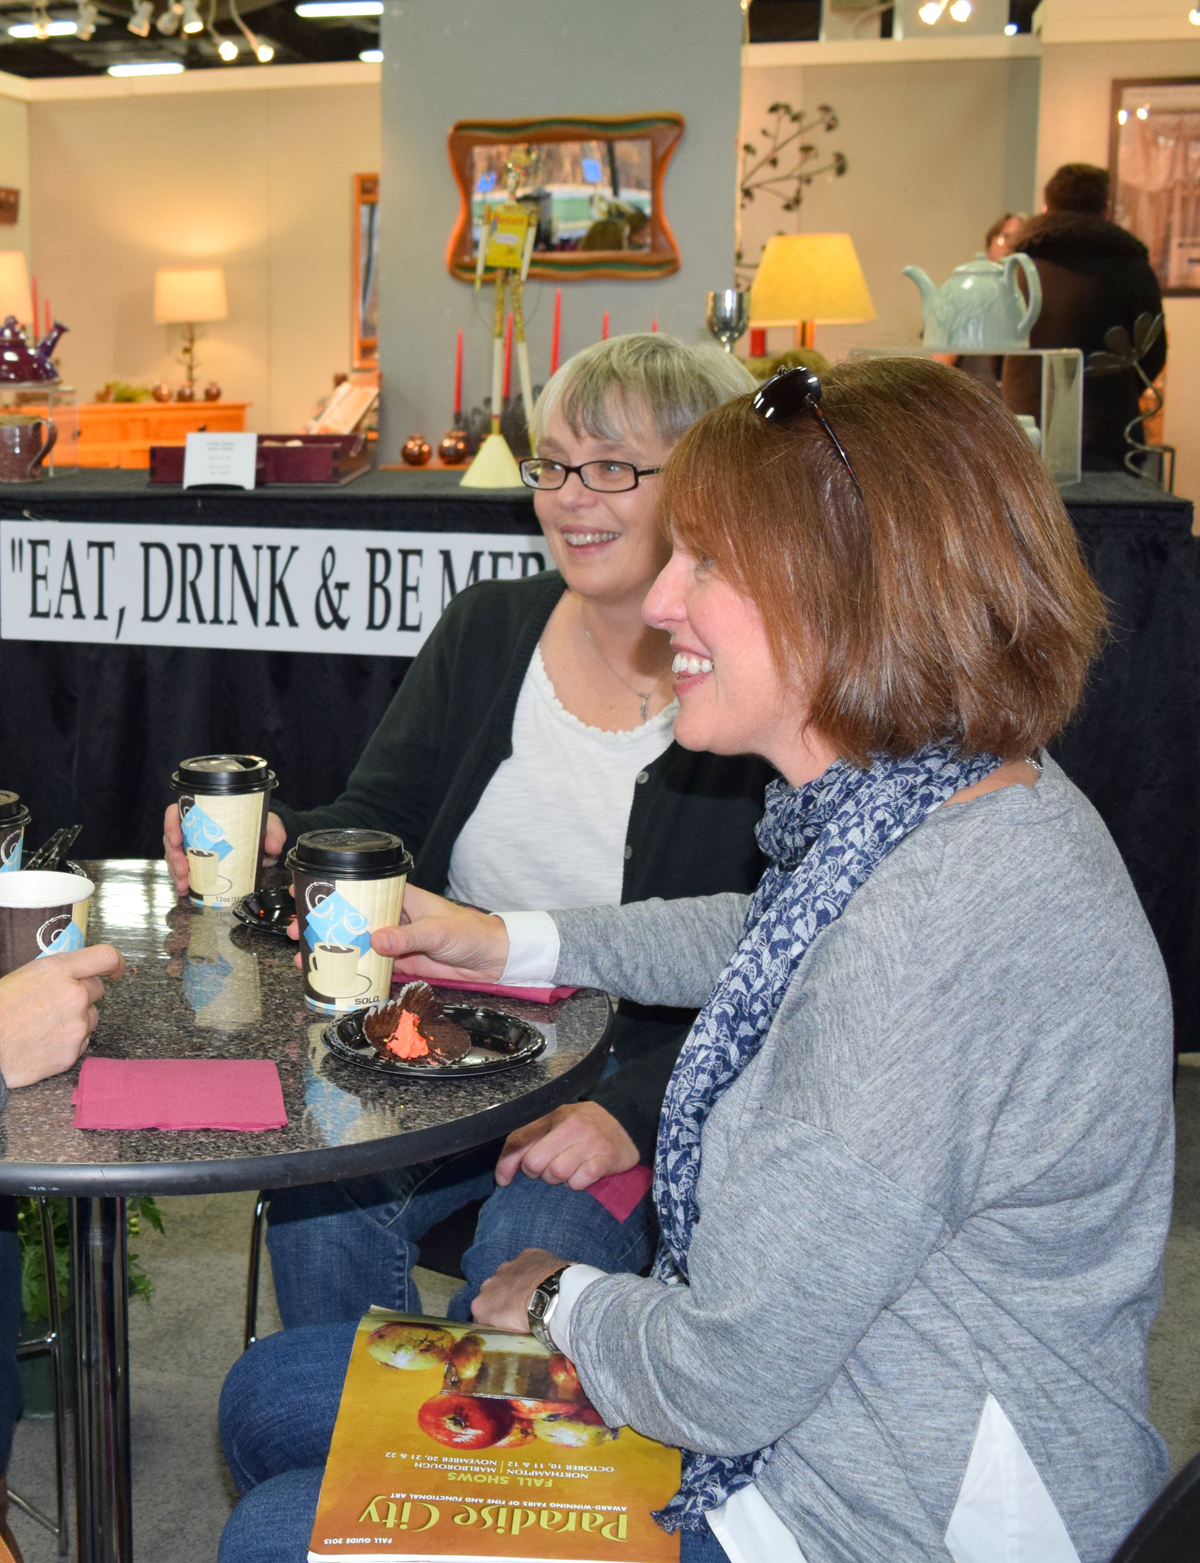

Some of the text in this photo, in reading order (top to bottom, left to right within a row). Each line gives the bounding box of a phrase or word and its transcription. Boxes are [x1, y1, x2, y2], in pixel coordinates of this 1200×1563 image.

[10, 537, 126, 640] "EAT,
[140, 541, 299, 628] DRINK
[314, 545, 350, 631] &
[365, 547, 423, 632] BE
[354, 995, 379, 1005] SOLO
[442, 1456, 498, 1466] NOVEMBER
[414, 1462, 497, 1473] MARLBOROUGH
[566, 1464, 614, 1472] OCTOBER
[506, 1468, 589, 1479] NORTHAMPTON
[447, 1472, 553, 1488] FALL SHOWS
[409, 1494, 463, 1502] FUNCTIONAL
[549, 1502, 627, 1511] AWARD-WINNING
[358, 1495, 628, 1543] Paradise City
